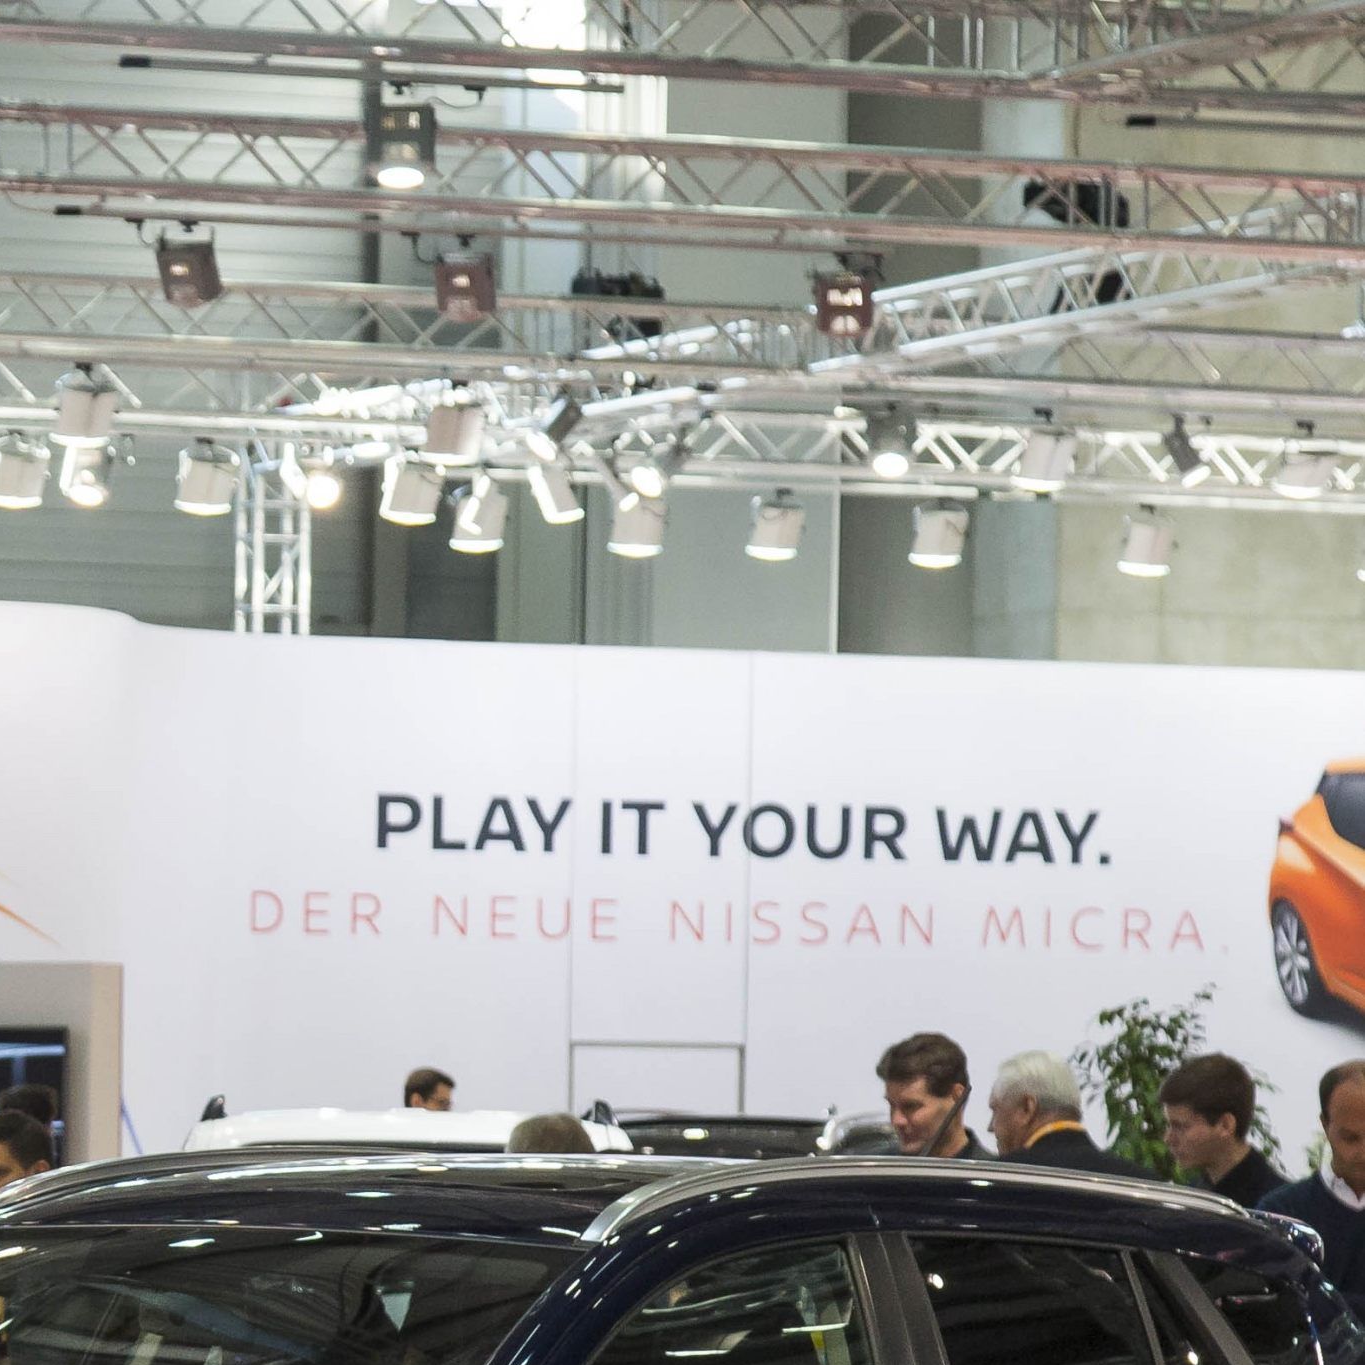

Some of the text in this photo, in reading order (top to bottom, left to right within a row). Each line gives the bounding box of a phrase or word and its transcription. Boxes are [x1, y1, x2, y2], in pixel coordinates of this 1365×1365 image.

[376, 794, 1111, 865] PLAY IT YOUR WAY.
[249, 889, 383, 936] DER
[432, 895, 620, 942] NEUE
[668, 900, 935, 946] NISSAN
